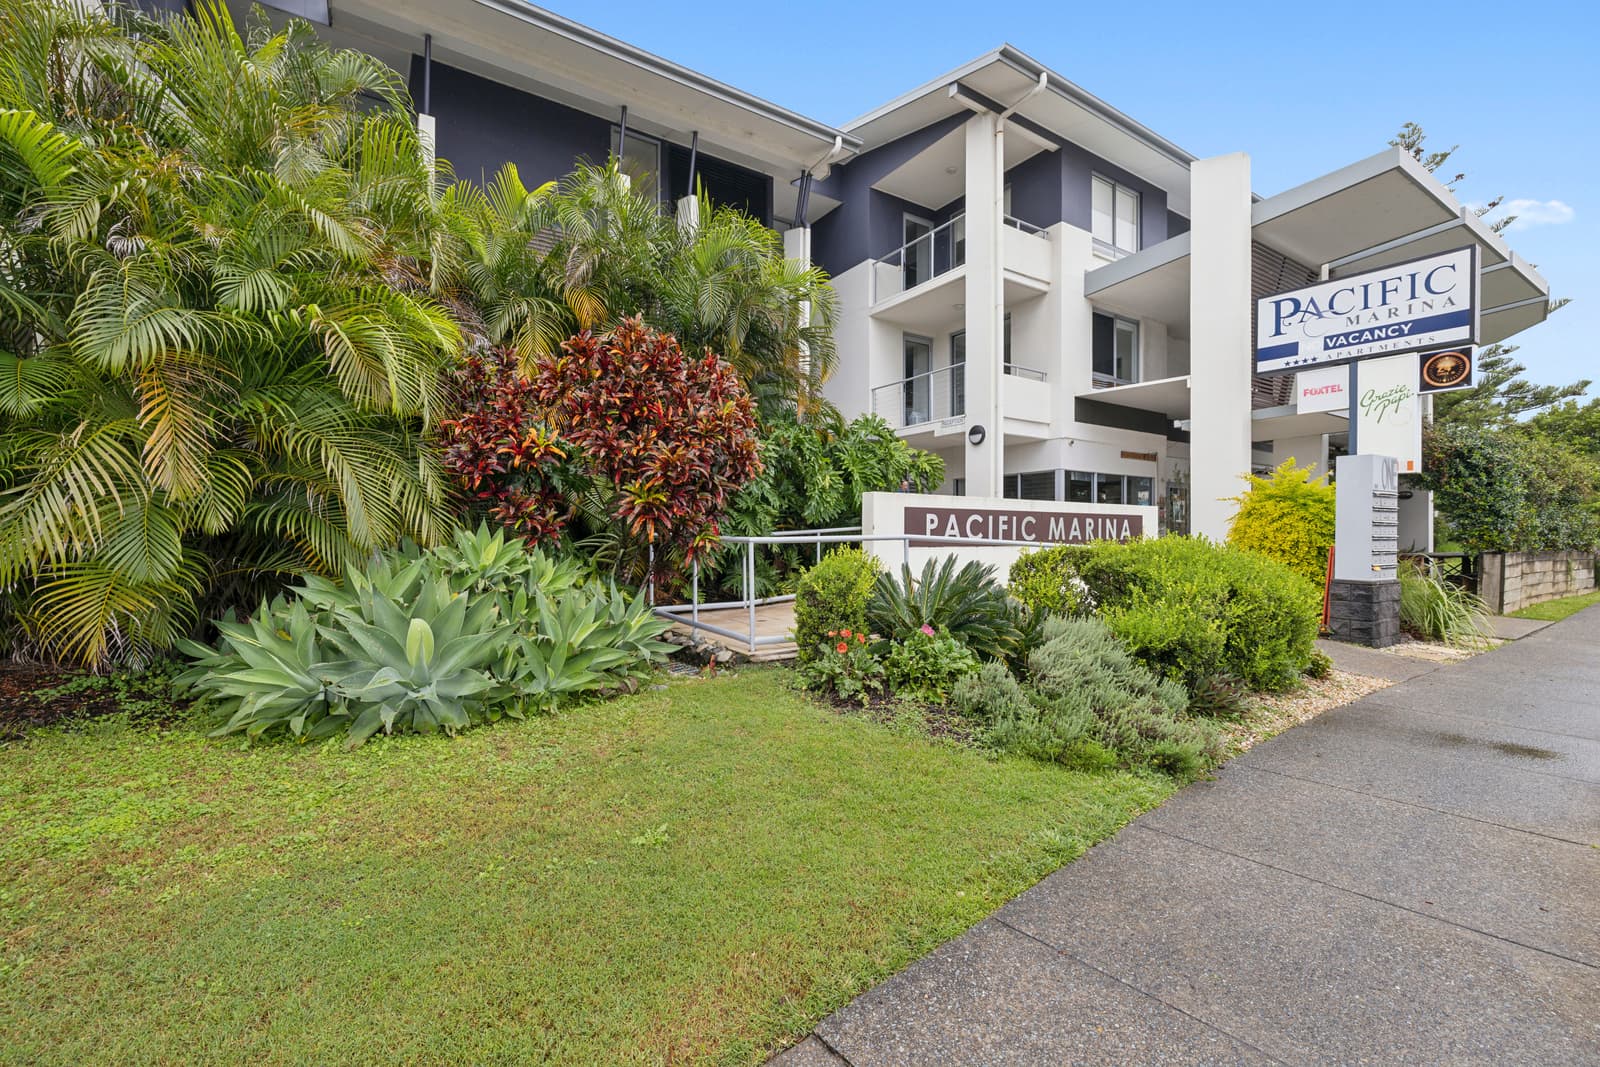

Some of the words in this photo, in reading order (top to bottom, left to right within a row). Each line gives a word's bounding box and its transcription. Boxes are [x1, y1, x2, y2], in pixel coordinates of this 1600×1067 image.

[1268, 263, 1457, 338] PACIFIC
[1345, 296, 1456, 328] MARINA
[1326, 323, 1413, 348] VACANCY
[1326, 335, 1436, 361] APARTMENTS
[1303, 384, 1344, 397] FOXTEL
[925, 513, 1037, 541] PACIFIC
[1049, 516, 1132, 541] MARINA
